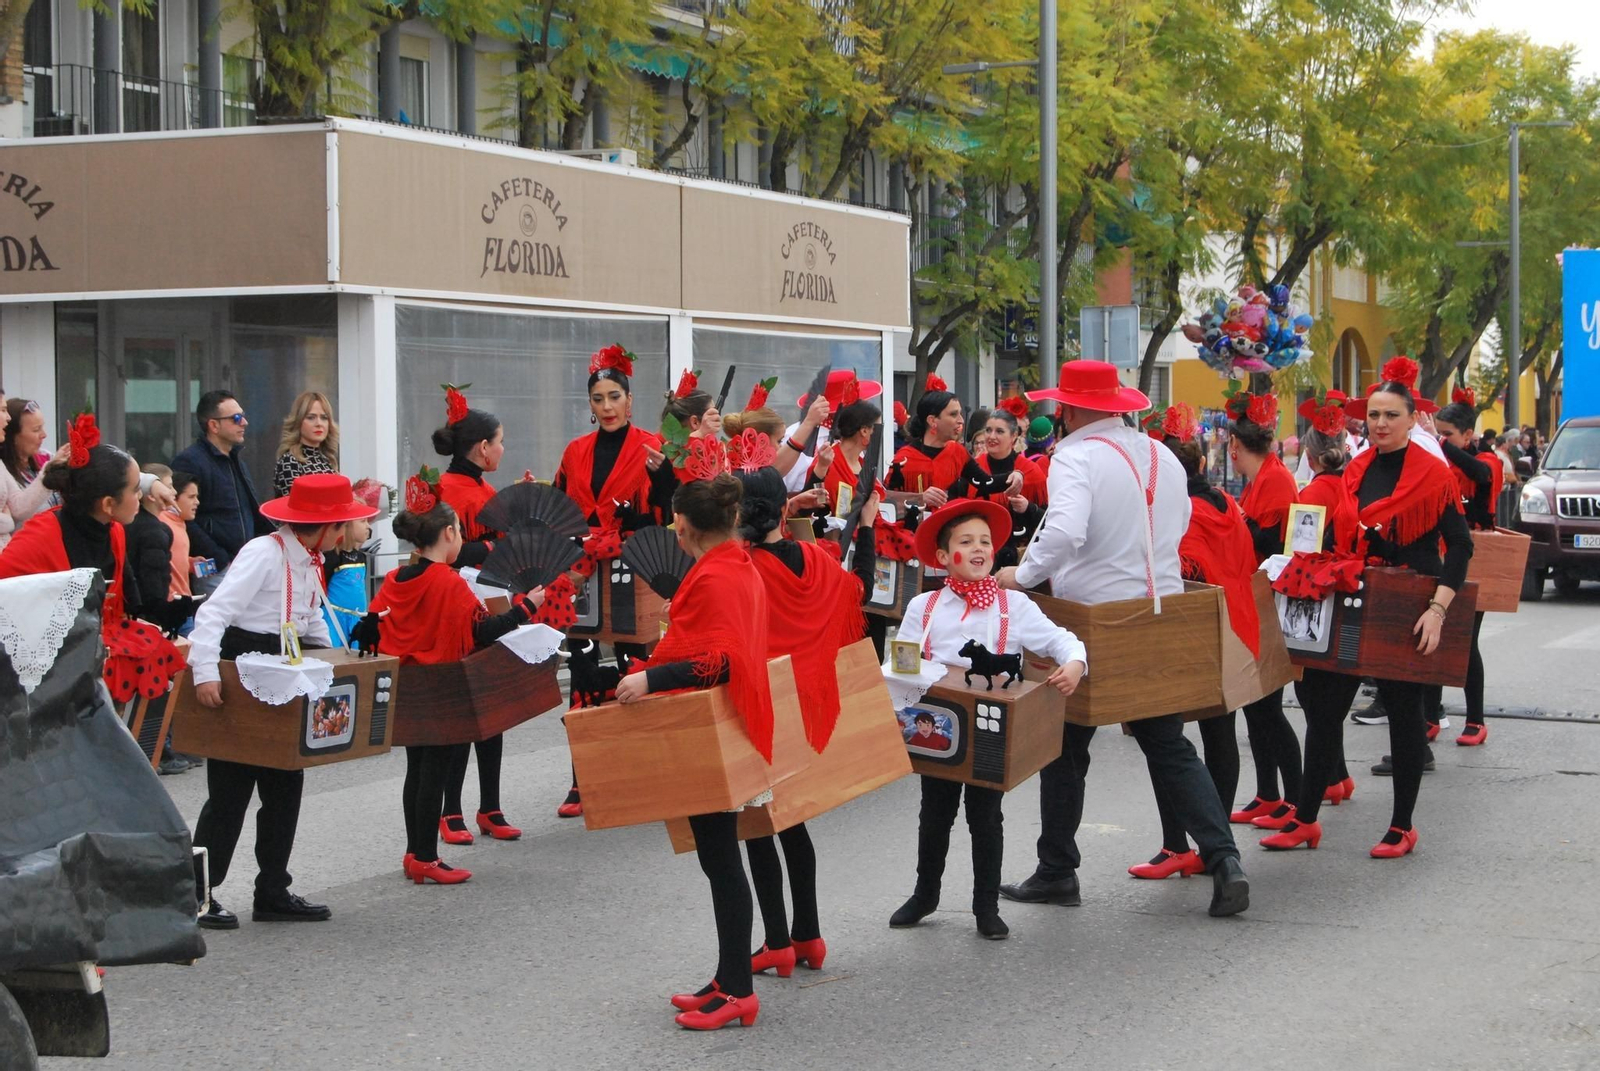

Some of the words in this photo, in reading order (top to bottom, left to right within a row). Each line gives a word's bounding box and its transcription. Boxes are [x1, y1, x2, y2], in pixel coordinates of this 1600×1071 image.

[0, 171, 55, 221] RIA
[481, 177, 569, 232] CAFETERIA
[480, 237, 570, 279] FLORIDA
[780, 221, 837, 266] CAFETERIA
[779, 269, 838, 304] FLORIDA
